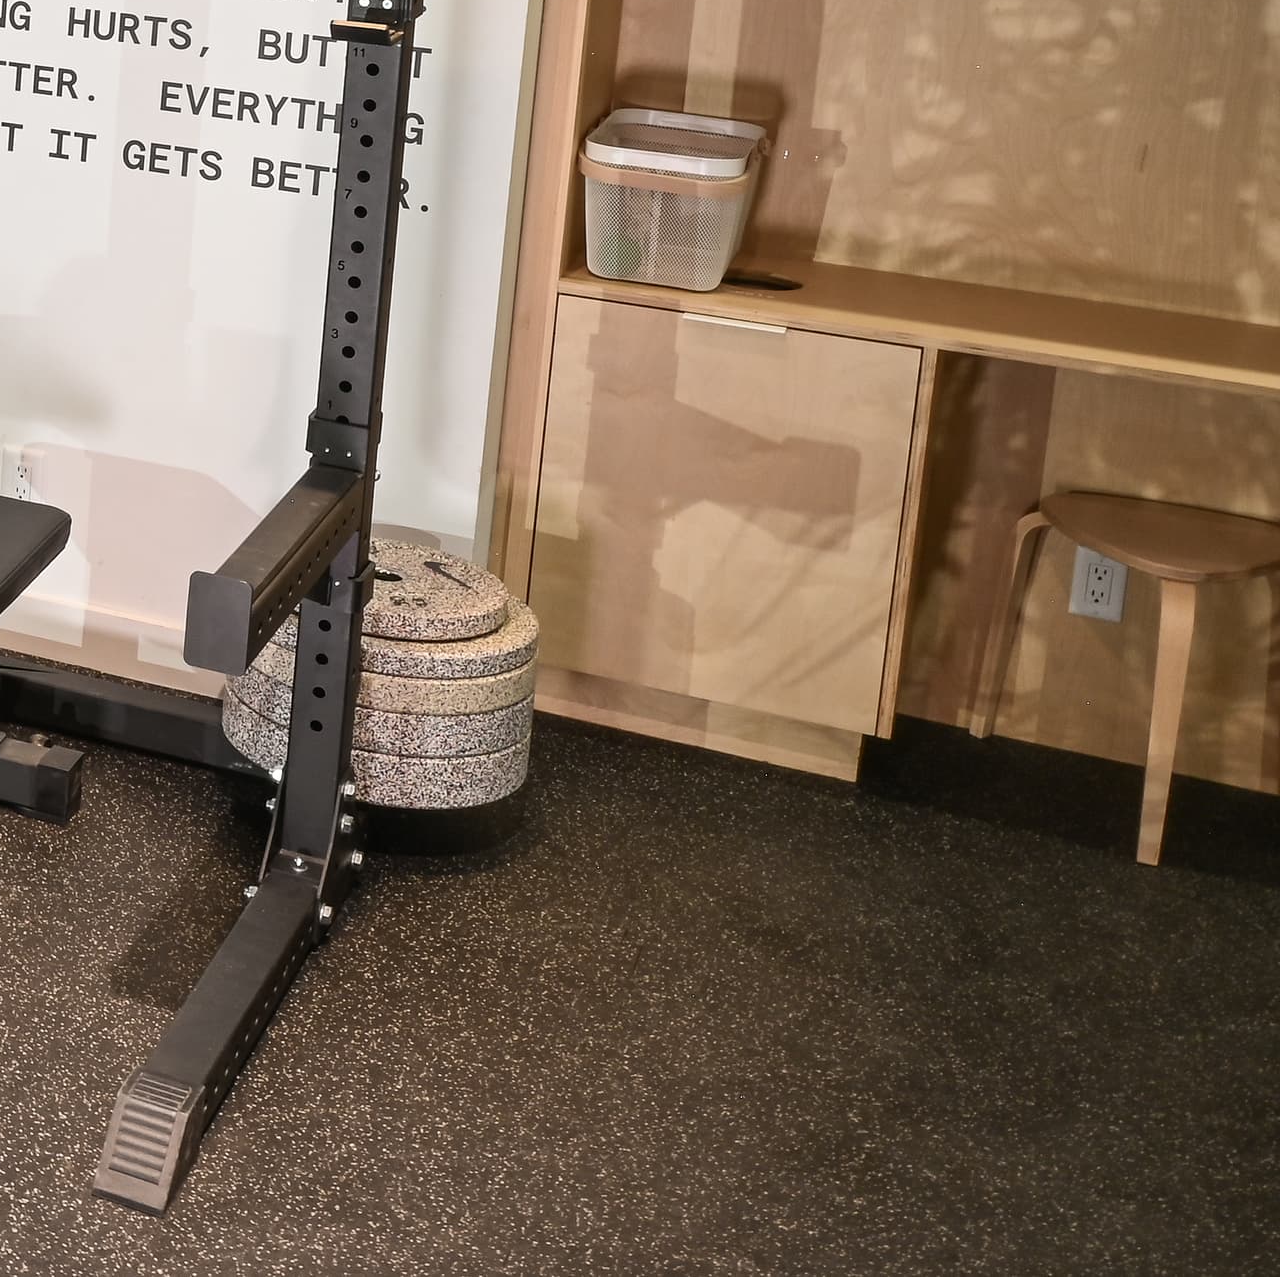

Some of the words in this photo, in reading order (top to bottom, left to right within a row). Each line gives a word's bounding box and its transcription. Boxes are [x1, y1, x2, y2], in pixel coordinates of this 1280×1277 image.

[67, 7, 209, 58] HURTS,
[257, 29, 337, 68] BUT
[352, 47, 367, 58] 11
[160, 81, 426, 146] EVERYTHG
[350, 118, 359, 129] 9
[48, 128, 97, 163] IT
[122, 139, 223, 181] GETS
[251, 157, 429, 212] BETR.
[344, 188, 353, 200] 7
[337, 260, 346, 271] 5
[331, 328, 339, 339] 3
[327, 400, 333, 410] 1
